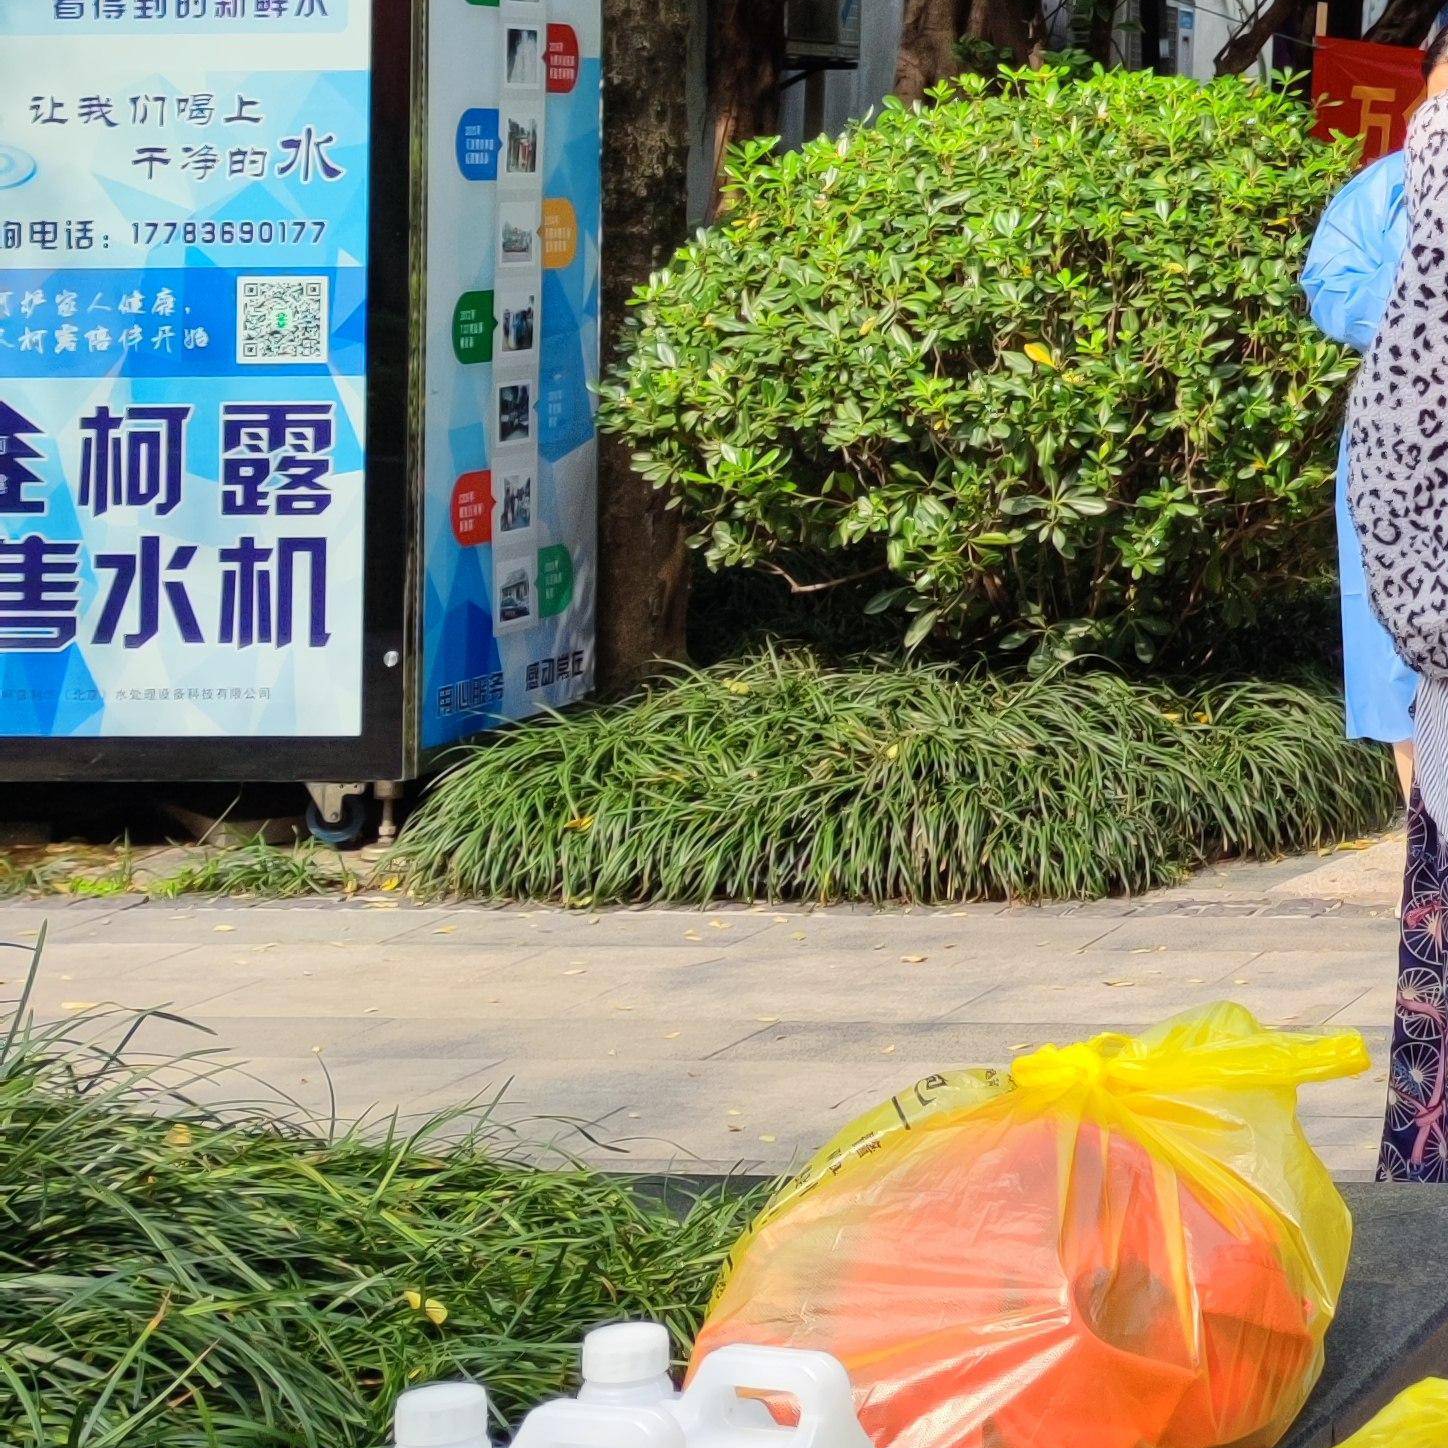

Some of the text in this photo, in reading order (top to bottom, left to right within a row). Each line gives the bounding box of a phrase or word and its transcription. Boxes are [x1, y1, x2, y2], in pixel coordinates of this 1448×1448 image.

[29, 94, 264, 128] 让我们喝上
[130, 127, 345, 183] 干净的水
[0, 534, 332, 650] 售水机
